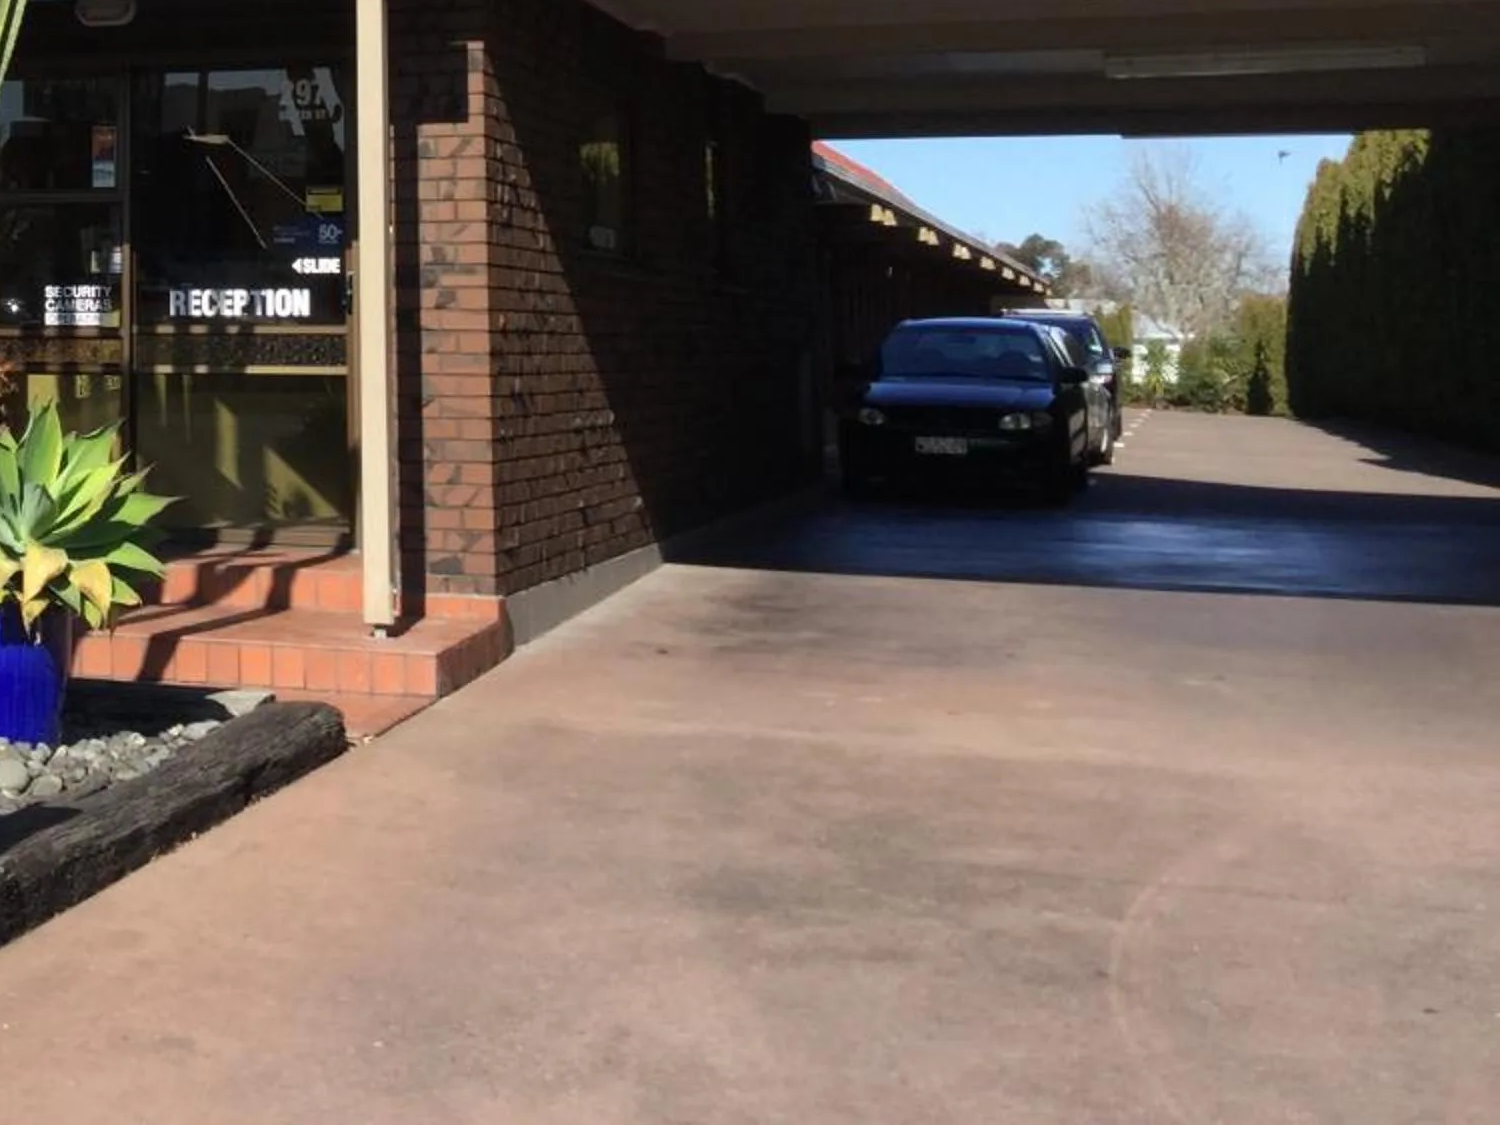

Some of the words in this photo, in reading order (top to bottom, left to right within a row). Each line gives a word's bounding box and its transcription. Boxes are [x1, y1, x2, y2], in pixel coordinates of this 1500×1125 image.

[303, 257, 341, 274] SLIDE
[44, 284, 112, 298] SECURITY
[44, 298, 113, 312] CAMERAS
[169, 287, 311, 318] RECEPTION
